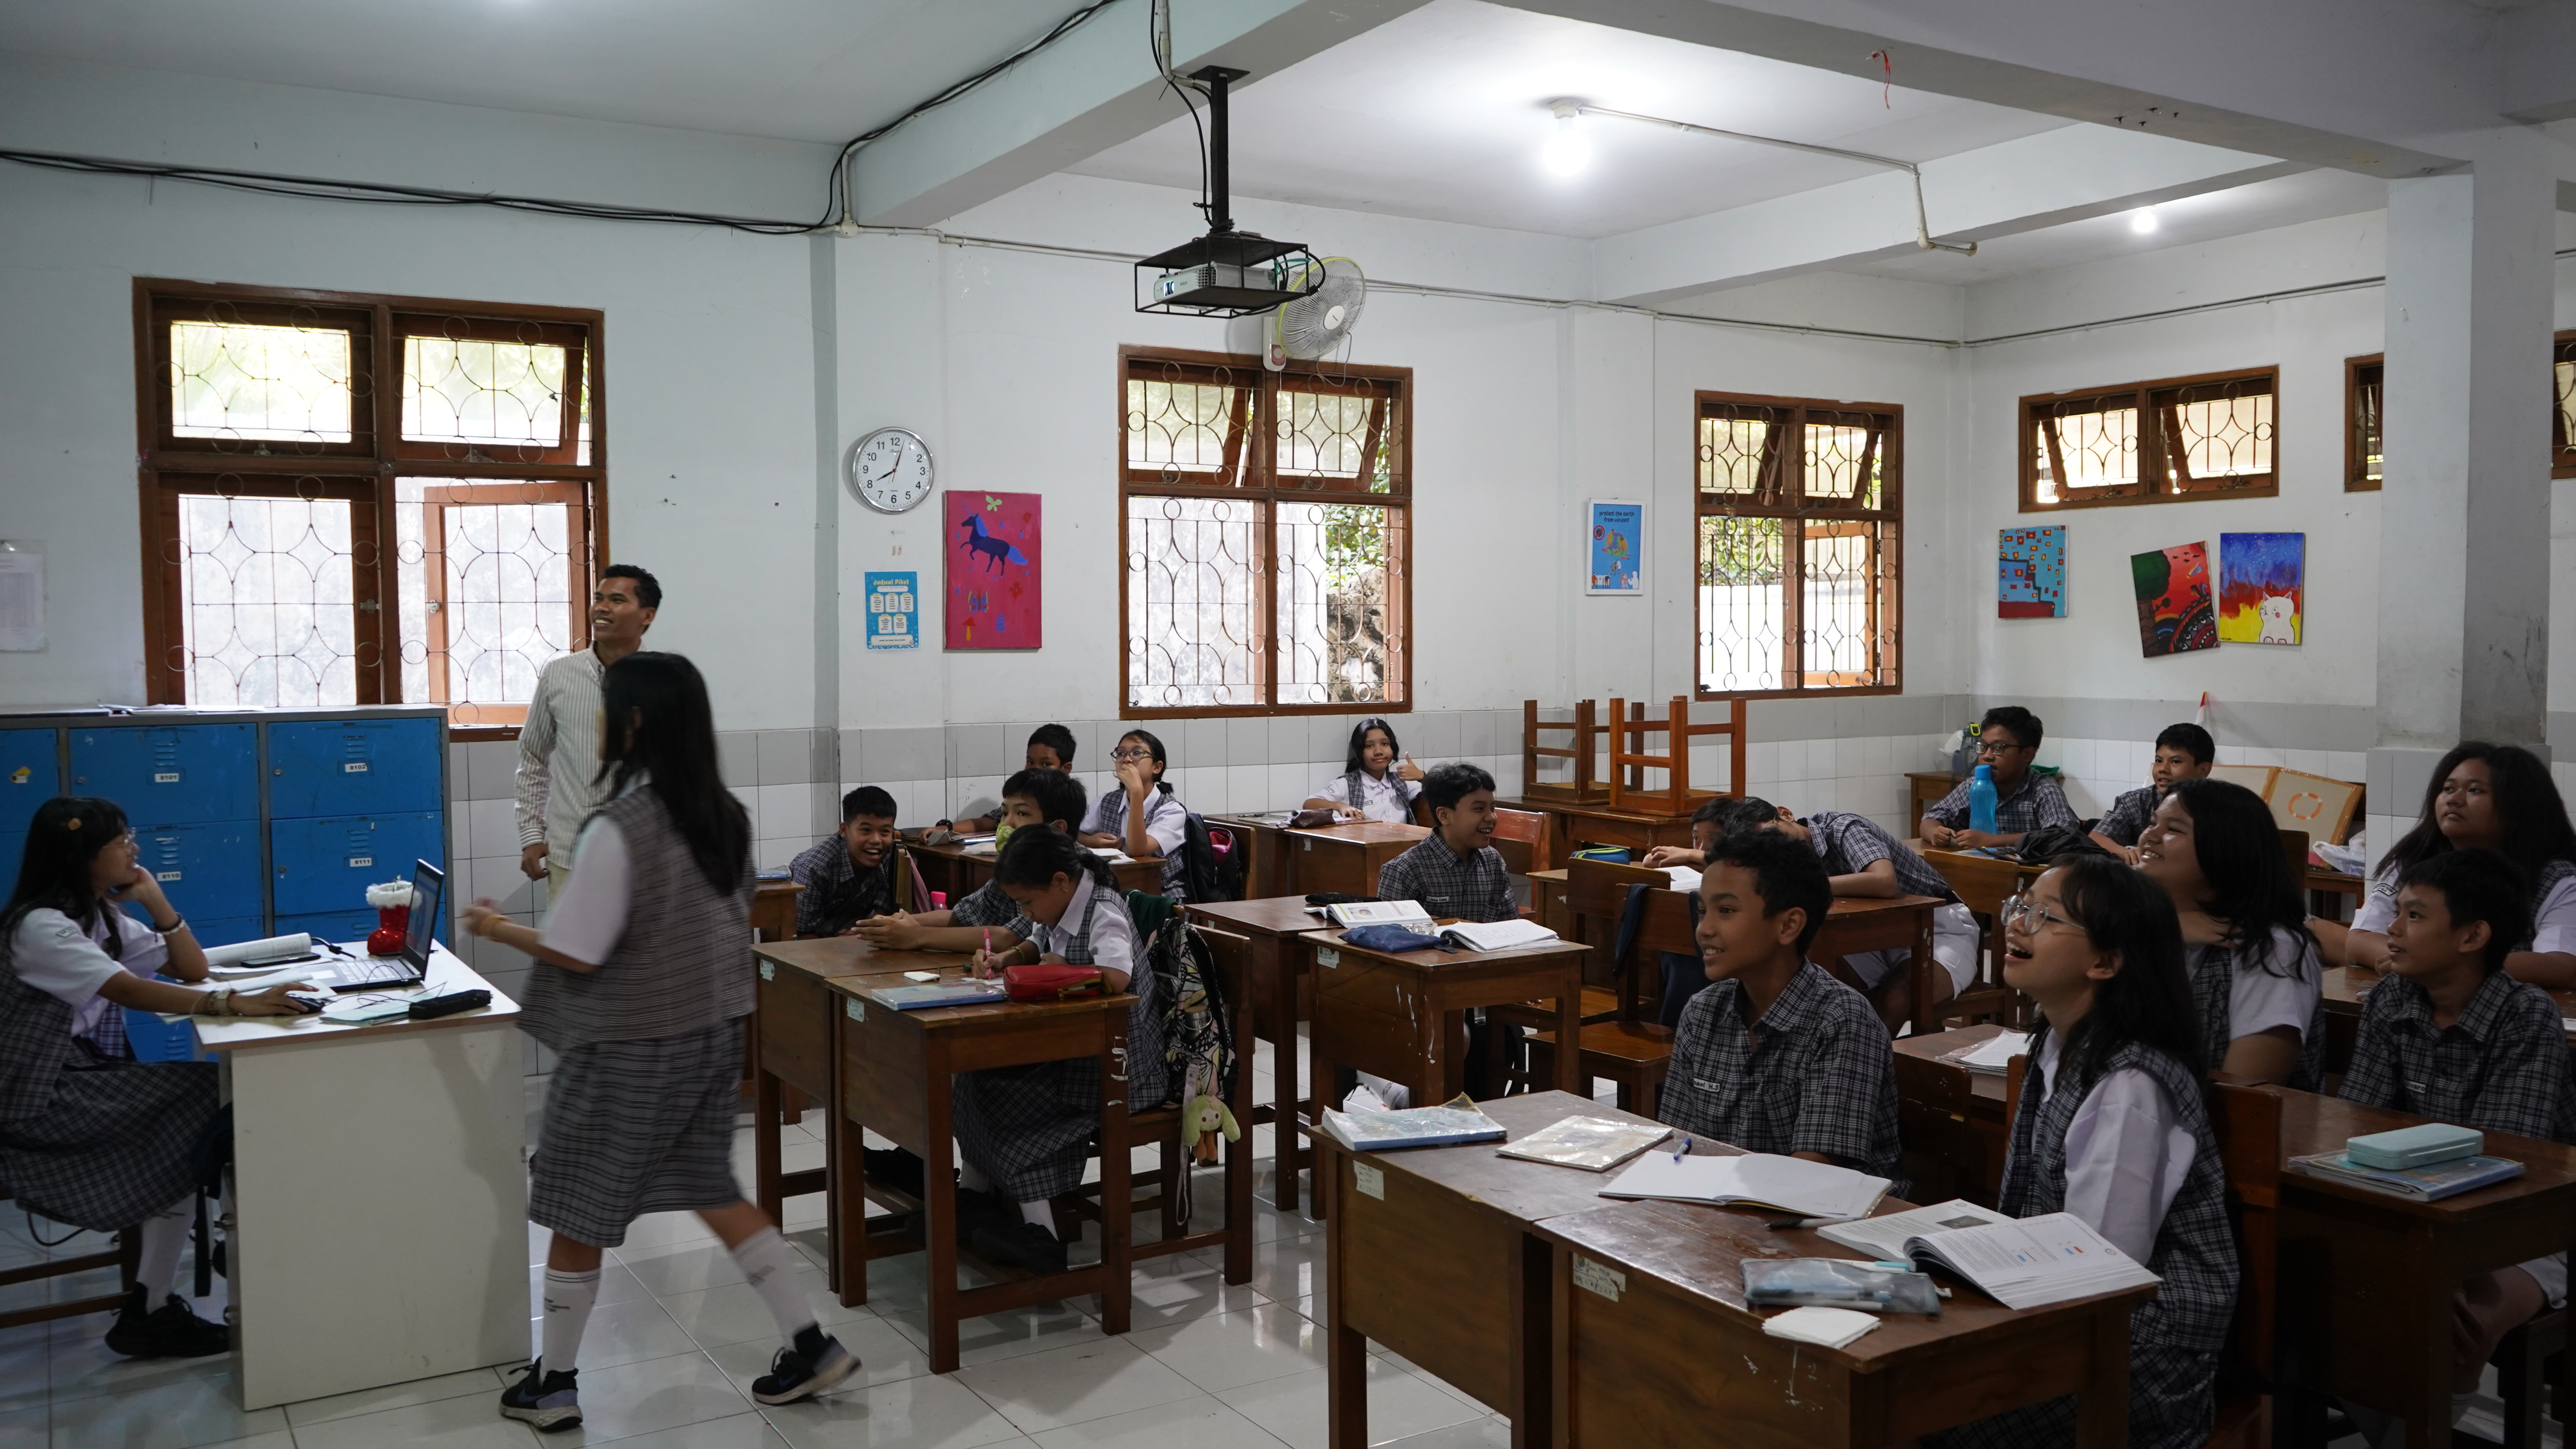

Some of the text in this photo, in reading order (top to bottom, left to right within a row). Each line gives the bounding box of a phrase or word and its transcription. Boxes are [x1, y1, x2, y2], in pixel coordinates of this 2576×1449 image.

[890, 437, 900, 446] 12
[867, 452, 877, 461] 10
[917, 454, 922, 462] 2
[863, 465, 868, 473] 9
[920, 467, 926, 475] 3
[867, 480, 872, 488] 8
[916, 481, 921, 489] 4
[878, 491, 883, 499] 7
[891, 494, 897, 503] 6
[905, 491, 911, 499] 5
